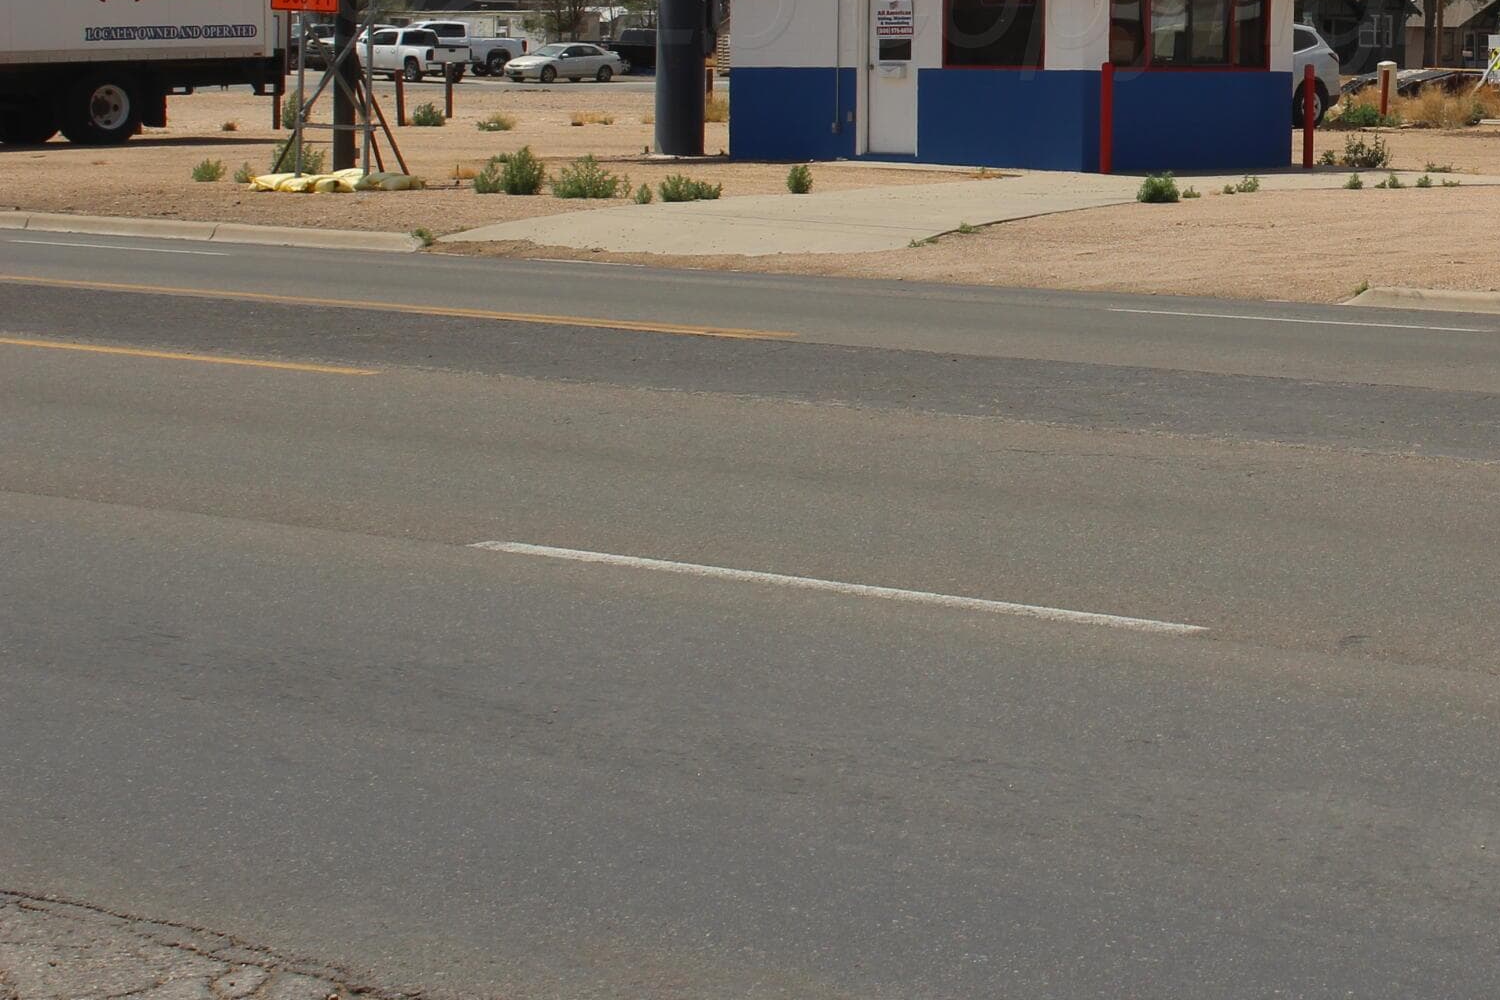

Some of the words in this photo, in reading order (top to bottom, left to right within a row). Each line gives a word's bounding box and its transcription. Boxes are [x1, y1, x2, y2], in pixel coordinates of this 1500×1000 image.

[85, 27, 137, 41] LOCALLY
[137, 26, 178, 40] OWNED
[178, 26, 201, 40] AND
[201, 24, 257, 39] OPERATED
